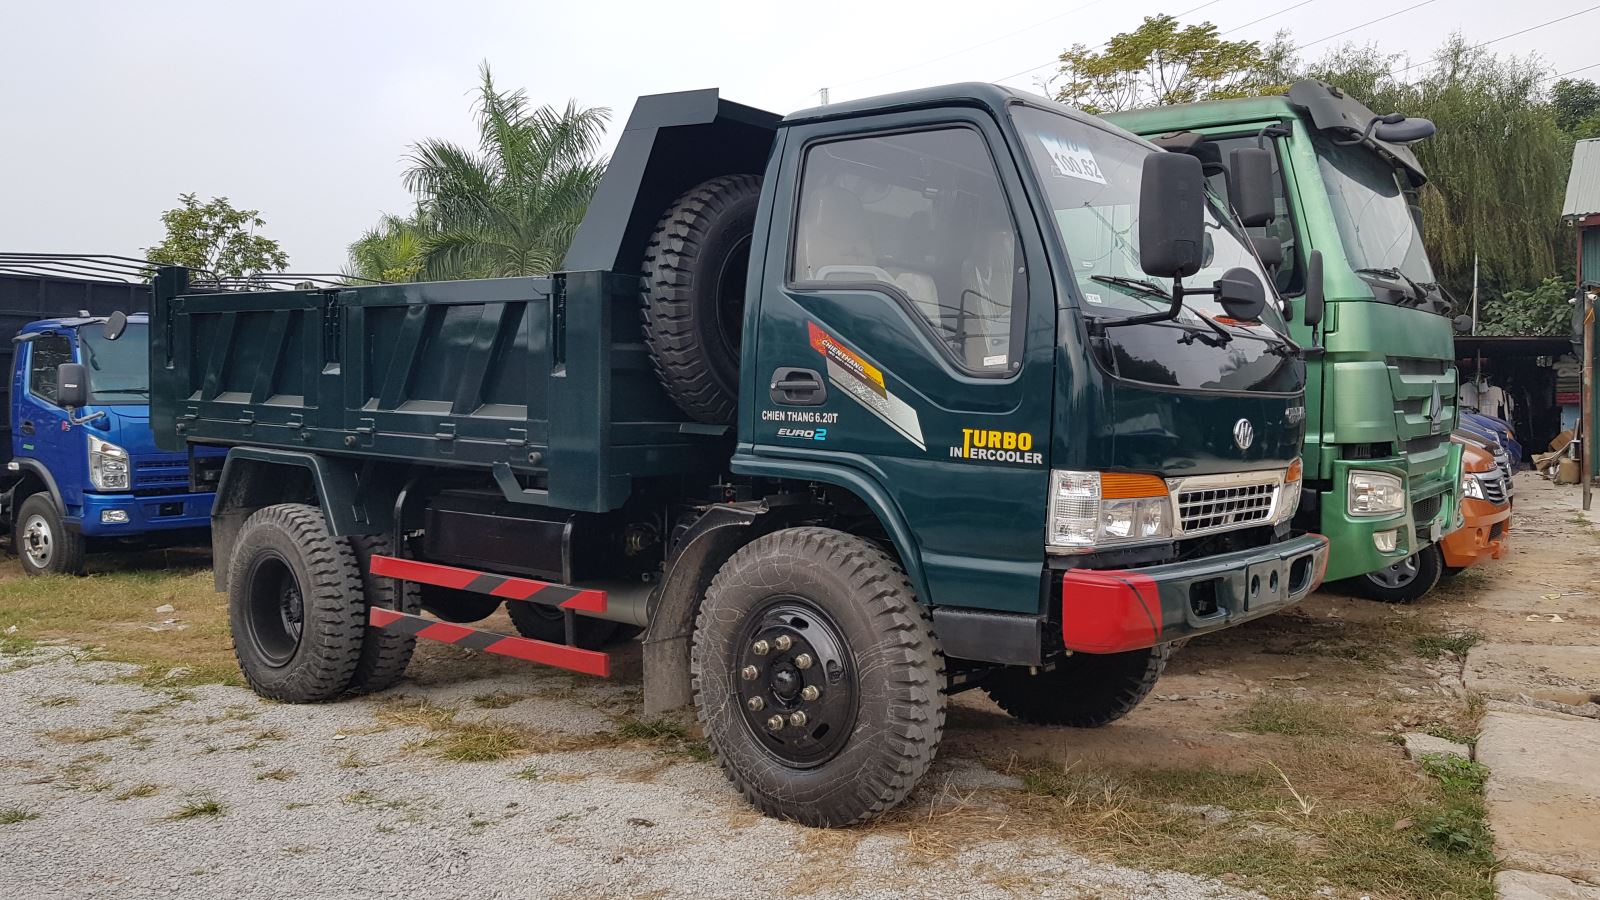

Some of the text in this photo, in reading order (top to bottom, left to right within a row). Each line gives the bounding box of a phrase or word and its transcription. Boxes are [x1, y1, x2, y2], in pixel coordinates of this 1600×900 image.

[1054, 152, 1103, 179] 100.62
[761, 410, 839, 424] CHIEN THANG 6.20T
[962, 428, 1032, 459] TURBO
[949, 446, 1043, 465] INTERCOOLER
